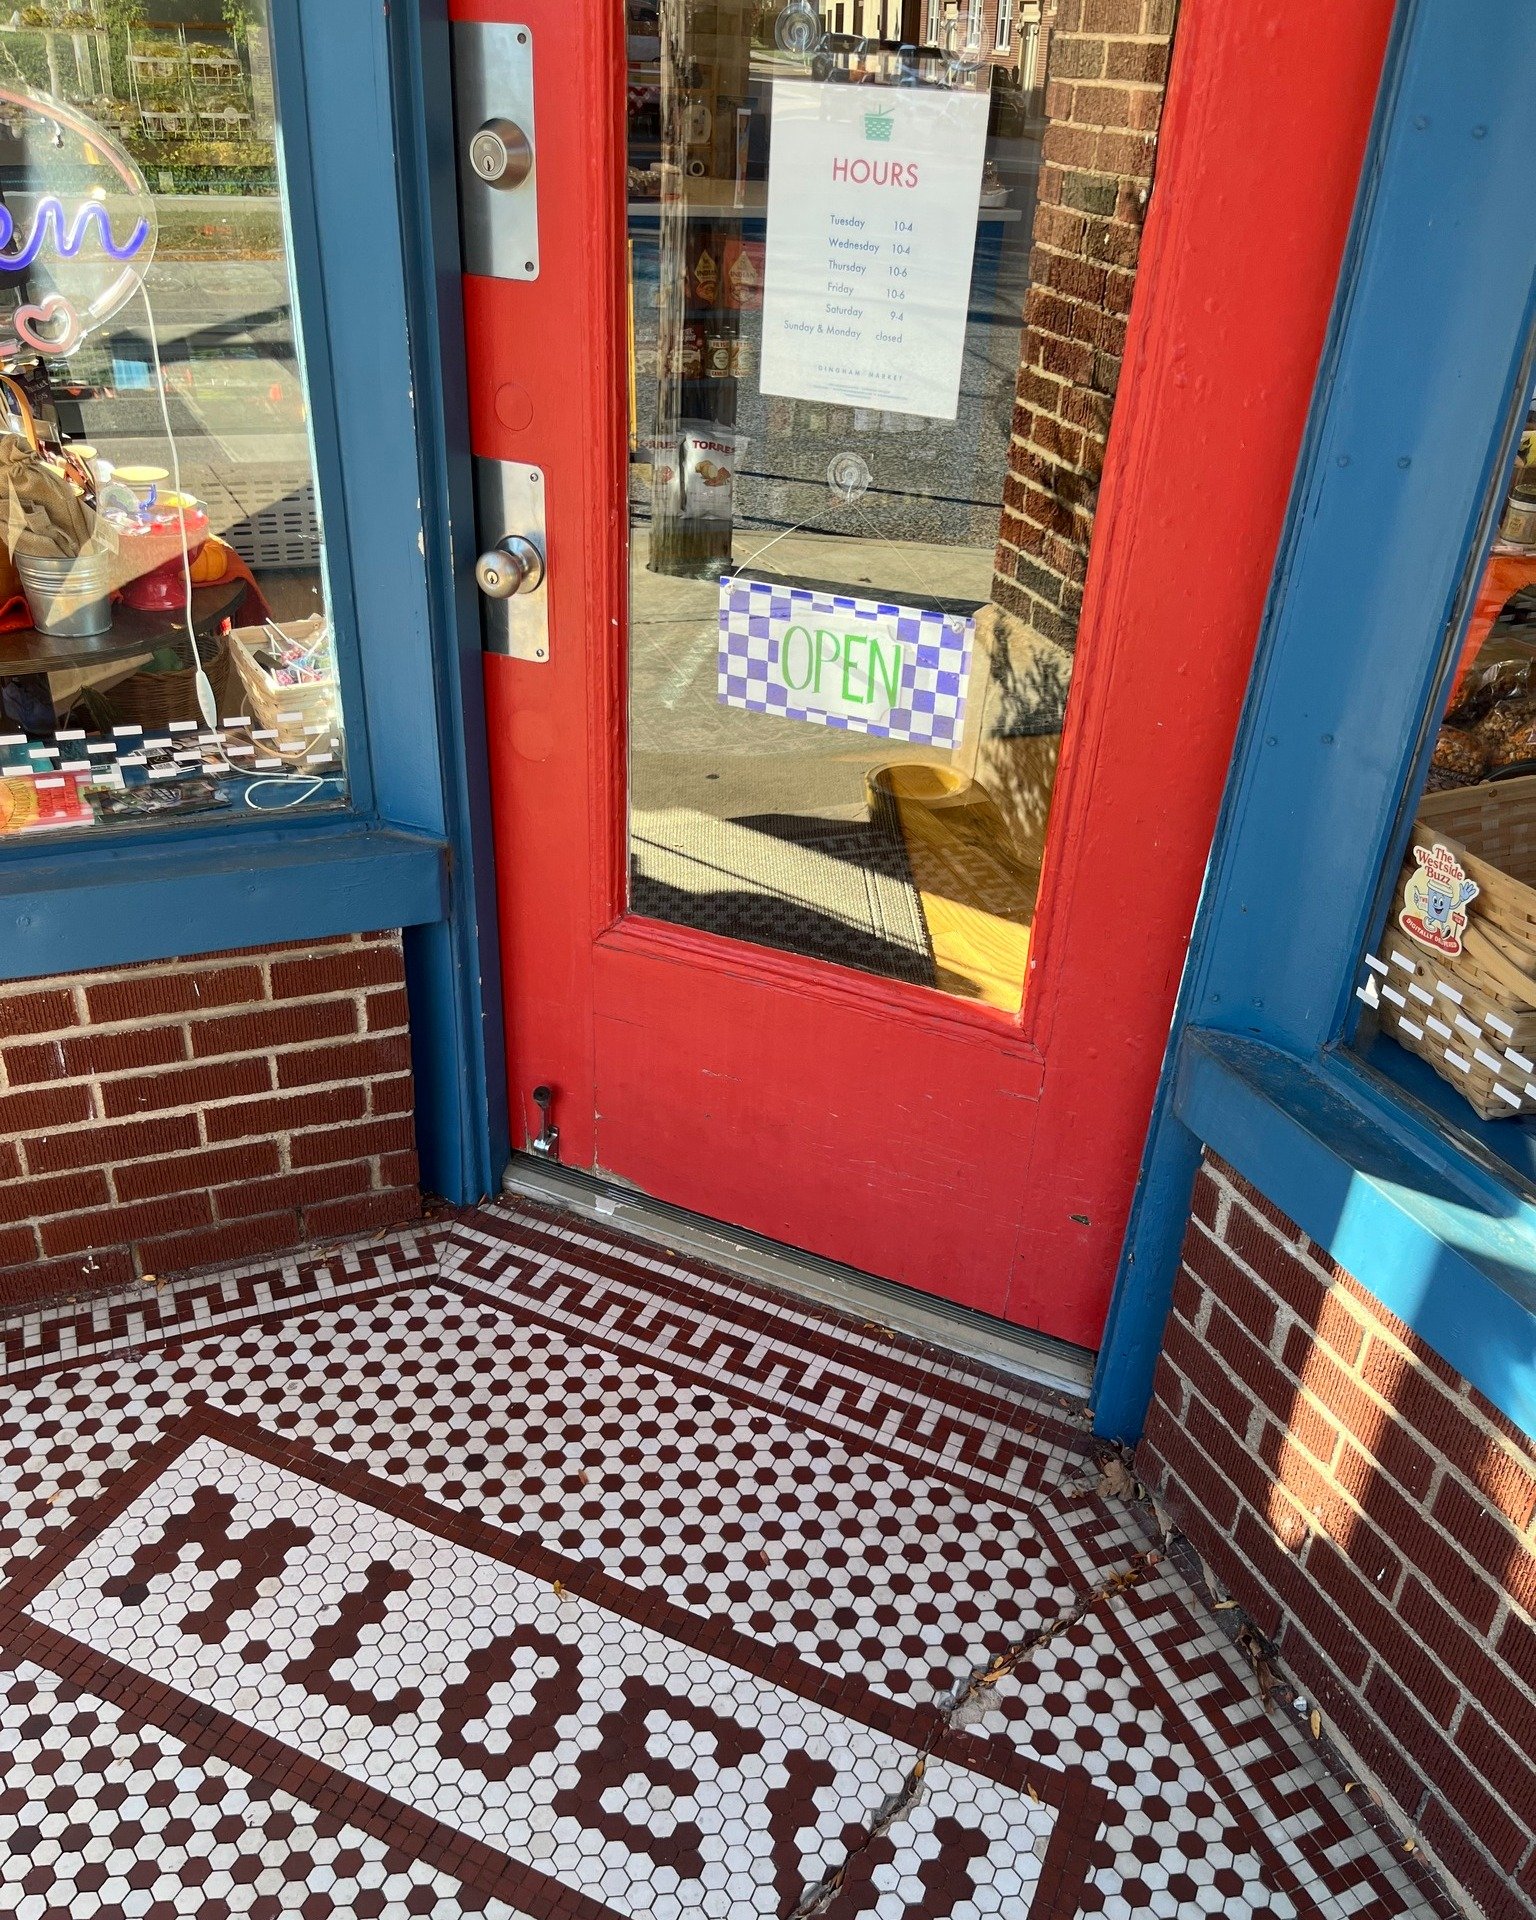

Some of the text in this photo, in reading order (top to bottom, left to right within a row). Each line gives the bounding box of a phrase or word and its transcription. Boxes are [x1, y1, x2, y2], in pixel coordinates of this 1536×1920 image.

[832, 157, 919, 189] HOURS
[830, 214, 913, 232] Tuesday 10-4
[828, 237, 911, 256] Wednesday 10-4
[828, 259, 908, 278] Thursday 10-6
[827, 281, 906, 300] Friday 10-6
[825, 303, 904, 322] Saturday 9-4
[783, 319, 903, 344] Sunday & Monday closed
[692, 440, 736, 454] TORRES
[781, 625, 901, 709] OPEN
[1416, 848, 1463, 881] Westside
[1435, 847, 1453, 865] The
[1424, 865, 1451, 885] Buzz
[1405, 918, 1434, 941] DIGITALLY
